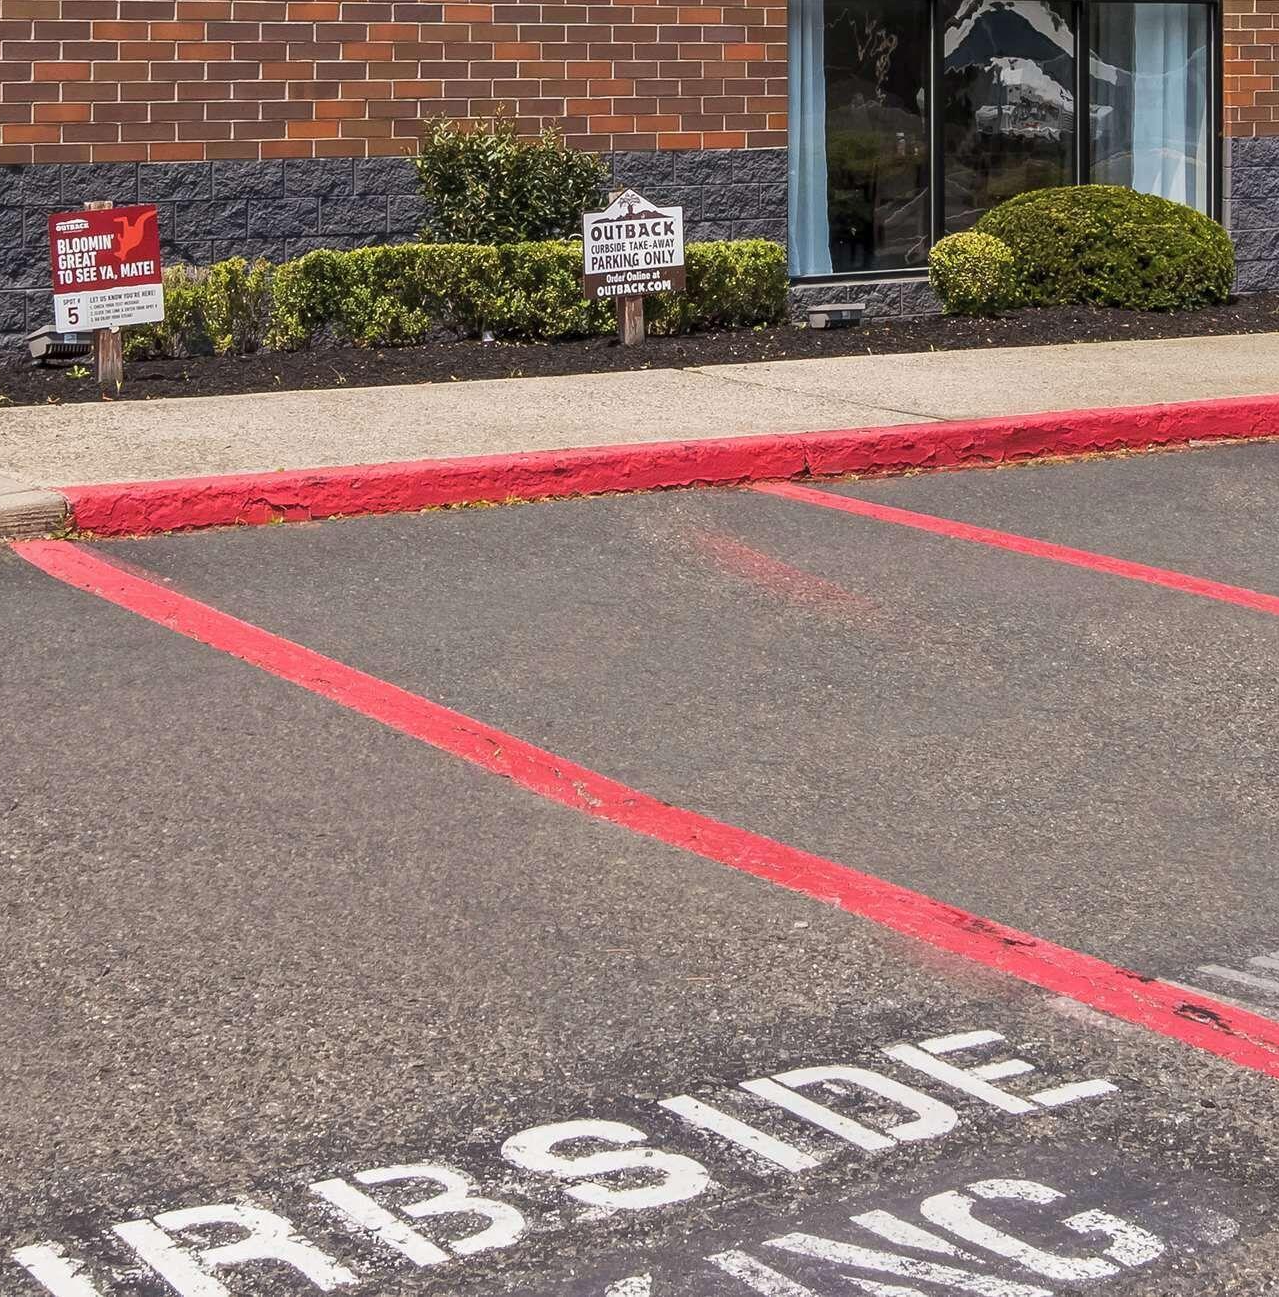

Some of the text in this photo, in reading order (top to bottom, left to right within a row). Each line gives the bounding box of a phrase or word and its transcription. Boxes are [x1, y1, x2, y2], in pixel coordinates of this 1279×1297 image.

[590, 221, 675, 242] OUTBACK
[57, 233, 114, 254] BLOOMIN'
[591, 238, 675, 255] CURBSIDE TAKE-AWAY
[58, 251, 97, 270] GREAT
[591, 249, 675, 272] PARKING ONLY
[57, 260, 154, 285] TO SEE YA, MATE!
[606, 270, 660, 283] Order Online at
[597, 279, 672, 297] OUTBACK.COM
[63, 298, 76, 306] SPOT
[89, 296, 99, 304] LET
[68, 306, 79, 325] 5
